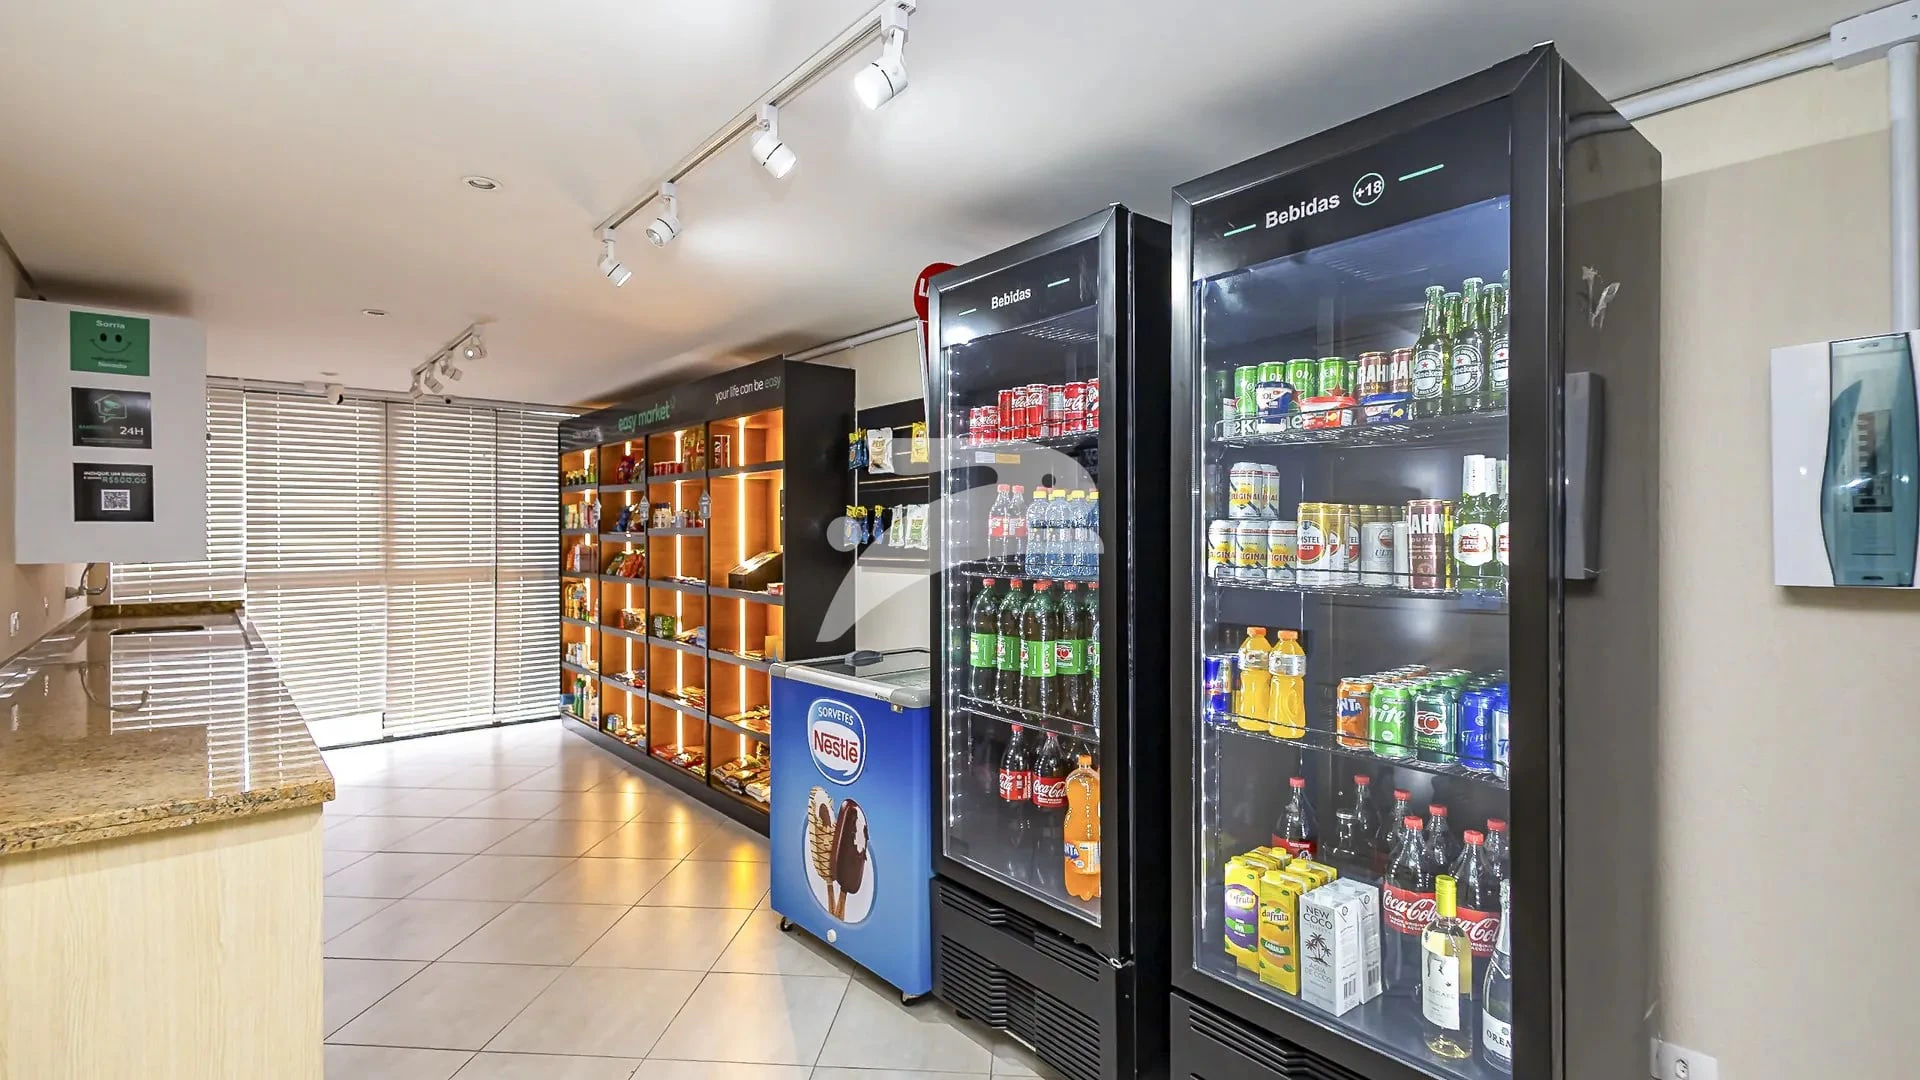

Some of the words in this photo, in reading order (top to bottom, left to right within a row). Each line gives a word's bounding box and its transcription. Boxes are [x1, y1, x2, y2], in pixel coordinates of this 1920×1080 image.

[1265, 194, 1341, 228] Bebidas
[1355, 180, 1382, 198] +18
[991, 287, 1032, 309] Bebidas
[95, 319, 126, 329] Sorria
[714, 388, 730, 405] your
[729, 382, 740, 398] life
[739, 382, 753, 396] can
[753, 377, 764, 391] be
[764, 374, 782, 390] easy
[617, 414, 637, 433] easy
[637, 402, 670, 426] market
[119, 426, 144, 436] 24H
[817, 706, 854, 726] SORVETES
[813, 729, 858, 764] Nestlé
[1033, 779, 1067, 798] Coca-Col
[1261, 909, 1290, 922] dafruta
[1303, 912, 1333, 930] COCO
[1306, 905, 1330, 920] NEW
